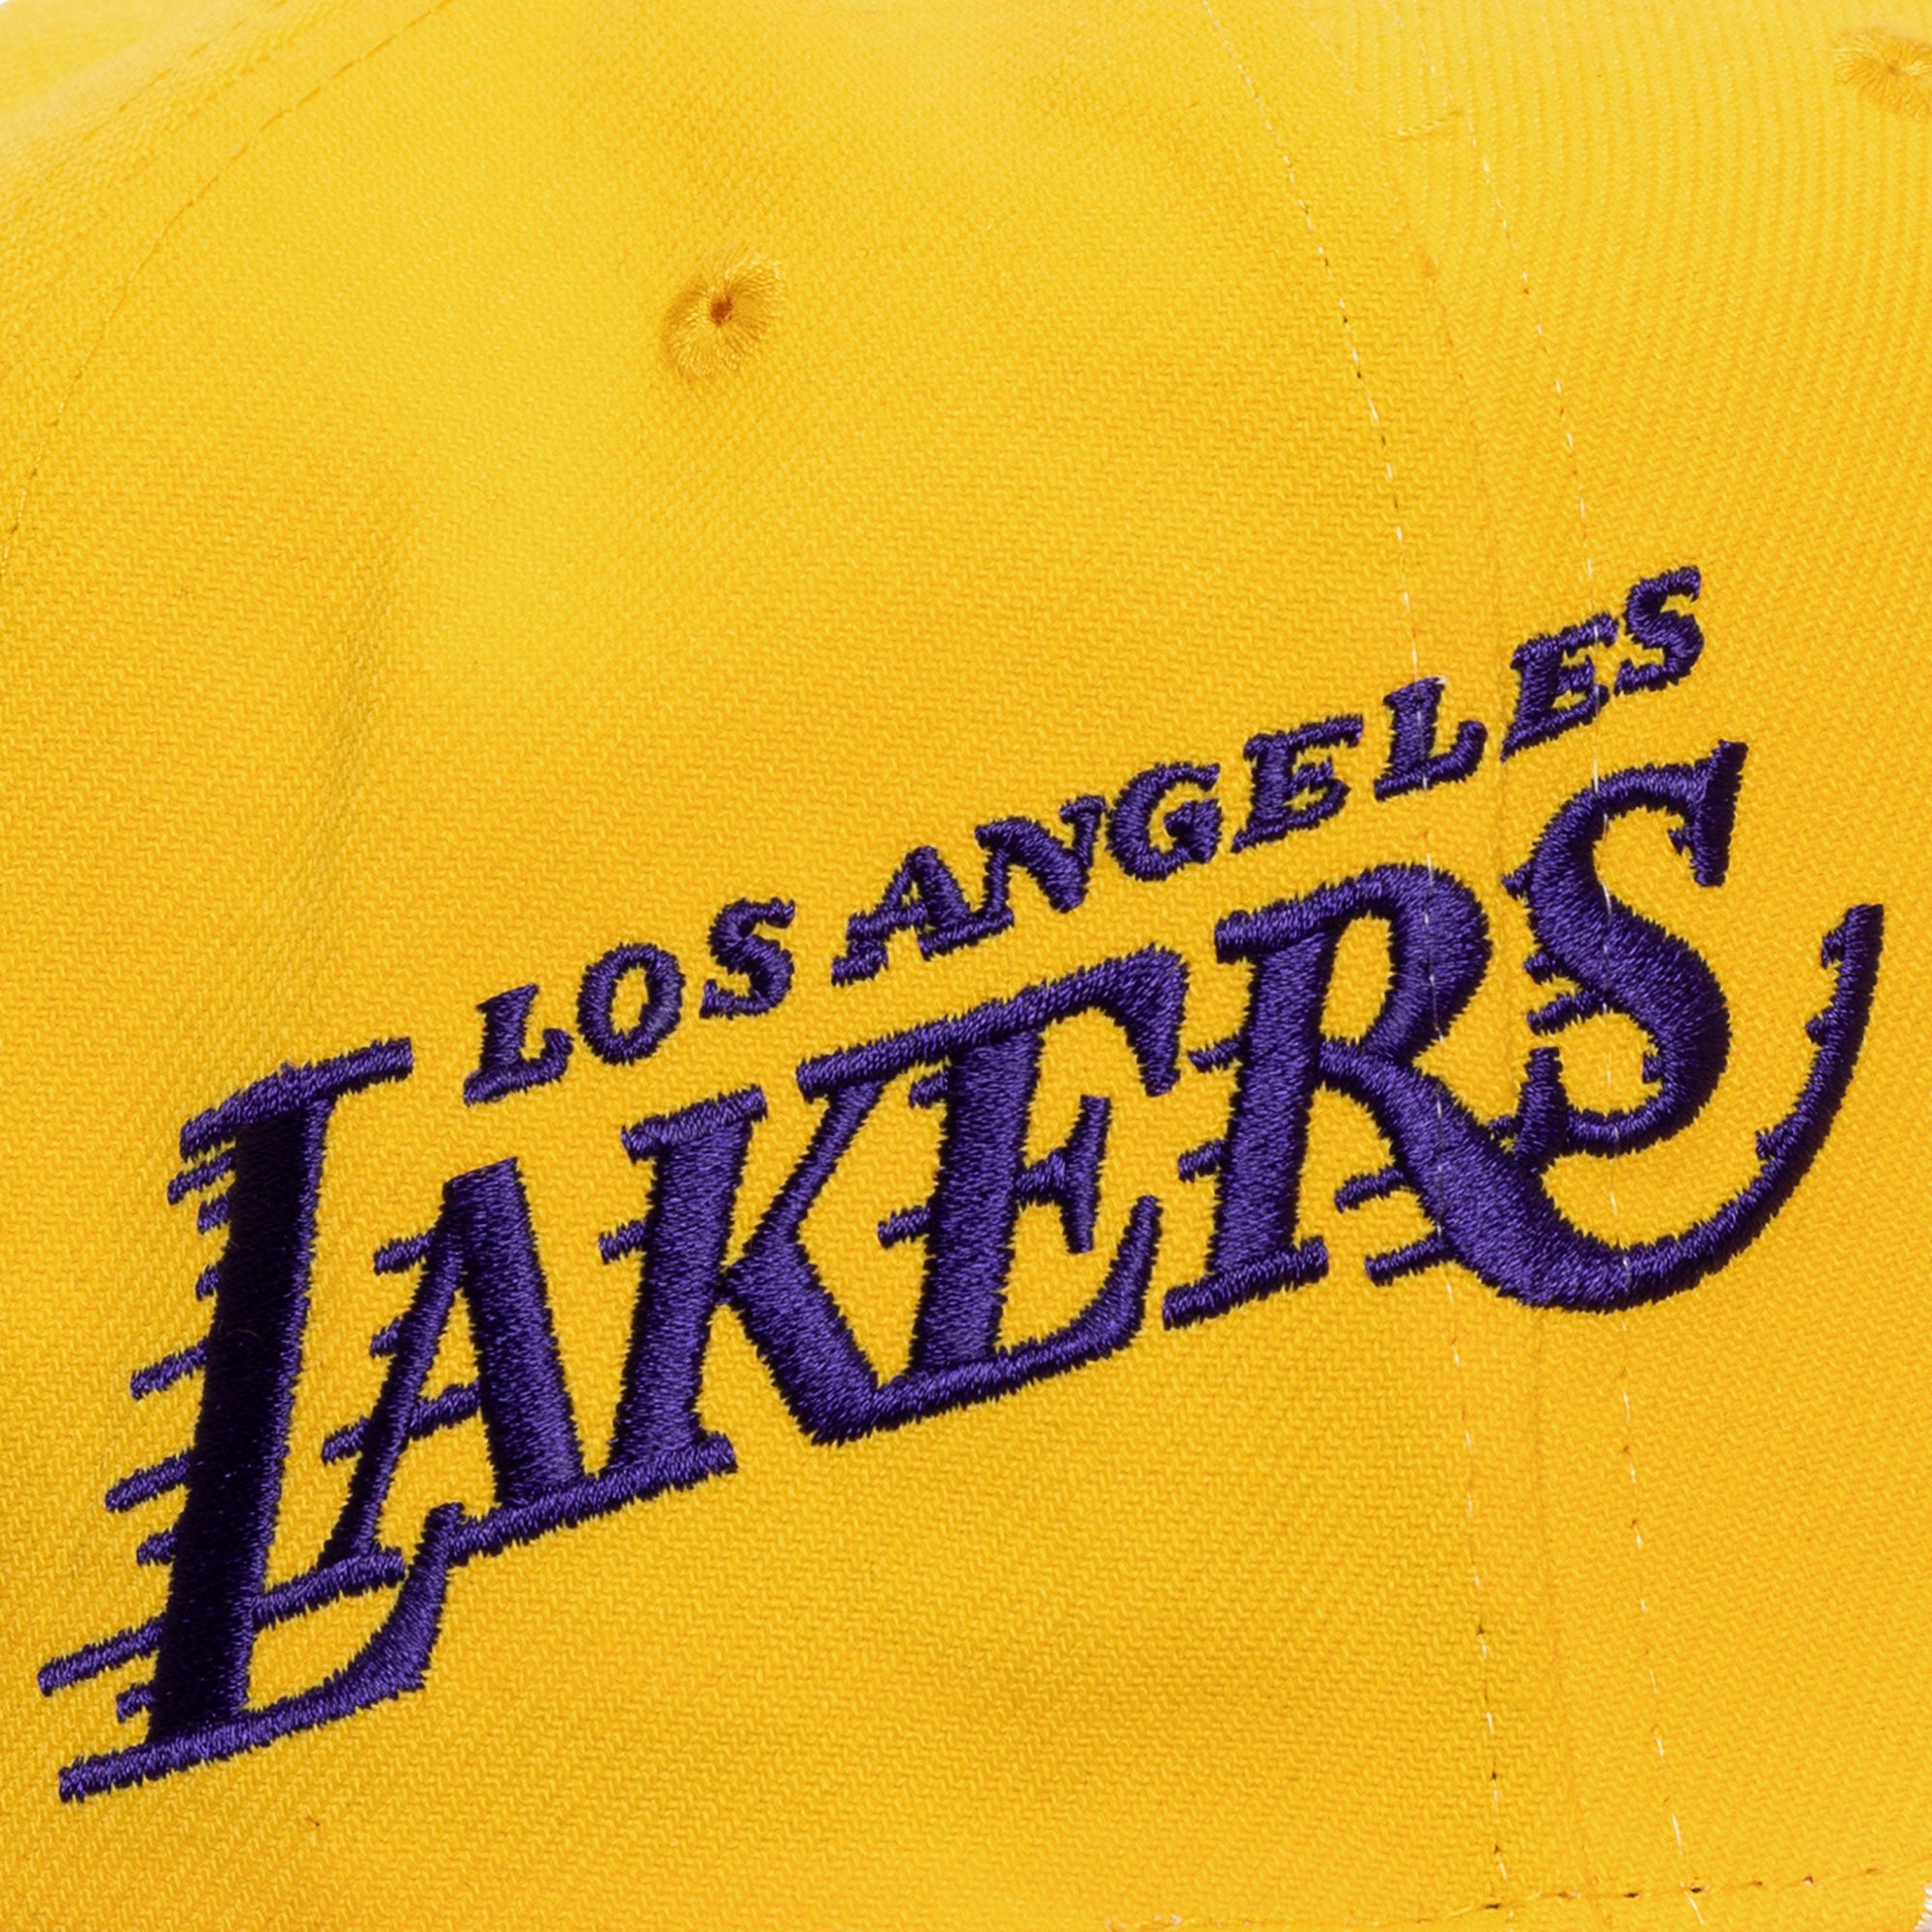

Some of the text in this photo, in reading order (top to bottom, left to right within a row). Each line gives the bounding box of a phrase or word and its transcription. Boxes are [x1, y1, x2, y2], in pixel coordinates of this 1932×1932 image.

[464, 566, 1704, 1106] LOS ANGELES
[38, 739, 1885, 1804] LAKERS
